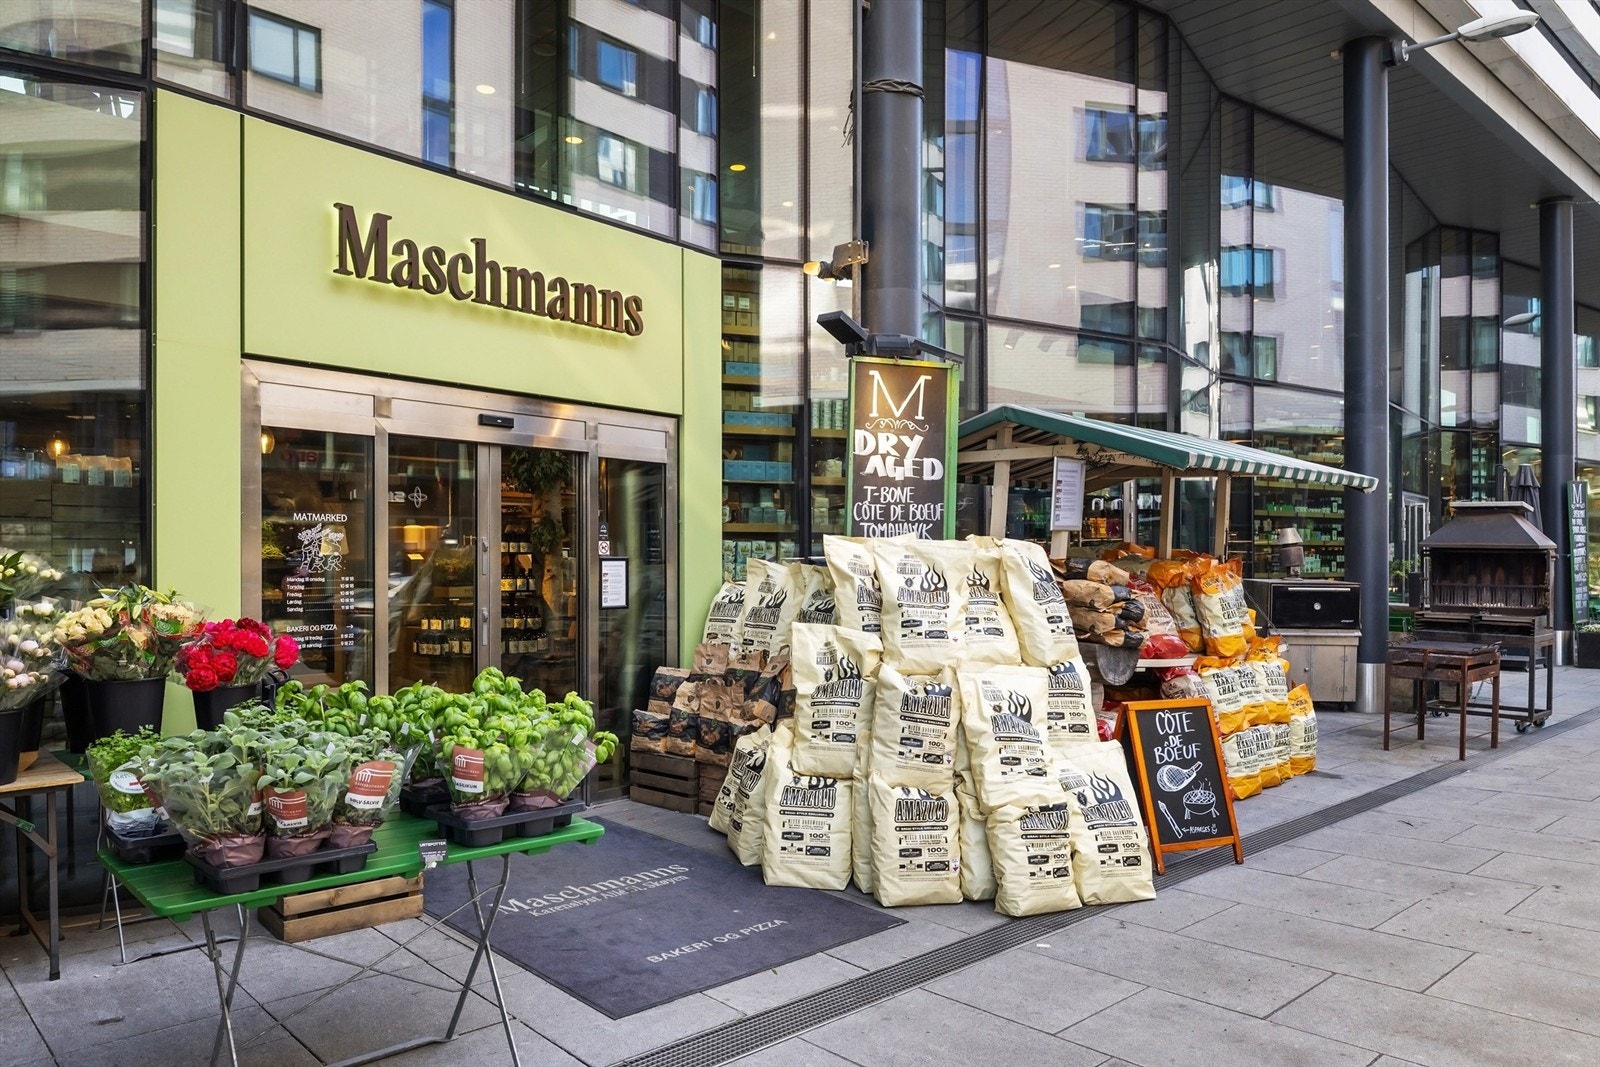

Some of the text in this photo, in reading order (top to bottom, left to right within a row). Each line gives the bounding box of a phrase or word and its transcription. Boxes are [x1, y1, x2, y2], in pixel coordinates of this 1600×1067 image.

[333, 202, 644, 336] Maschmanns
[869, 370, 932, 420] M
[853, 429, 924, 460] DRY
[860, 454, 944, 480] AGED
[863, 486, 915, 503] T-BONE
[293, 512, 348, 522] MATMARKED
[853, 502, 944, 521] CÔTE DE BOEUF
[860, 522, 933, 540] TOMAHAWK
[811, 679, 863, 700] AMAZULU
[900, 692, 951, 719] AMAZULU
[835, 720, 855, 728] 100%
[991, 713, 1040, 739] AMAZULU
[1155, 710, 1195, 735] CÔTE
[928, 740, 945, 748] 100%
[1169, 734, 1183, 747] DE
[780, 785, 836, 809] AMAZULU
[894, 799, 950, 823] AMAZULU
[1080, 799, 1134, 823] AMAZULU
[490, 863, 690, 915] Maschmanns
[646, 875, 689, 889] Skøyen
[646, 918, 788, 963] BAKERI OG PIZZA
